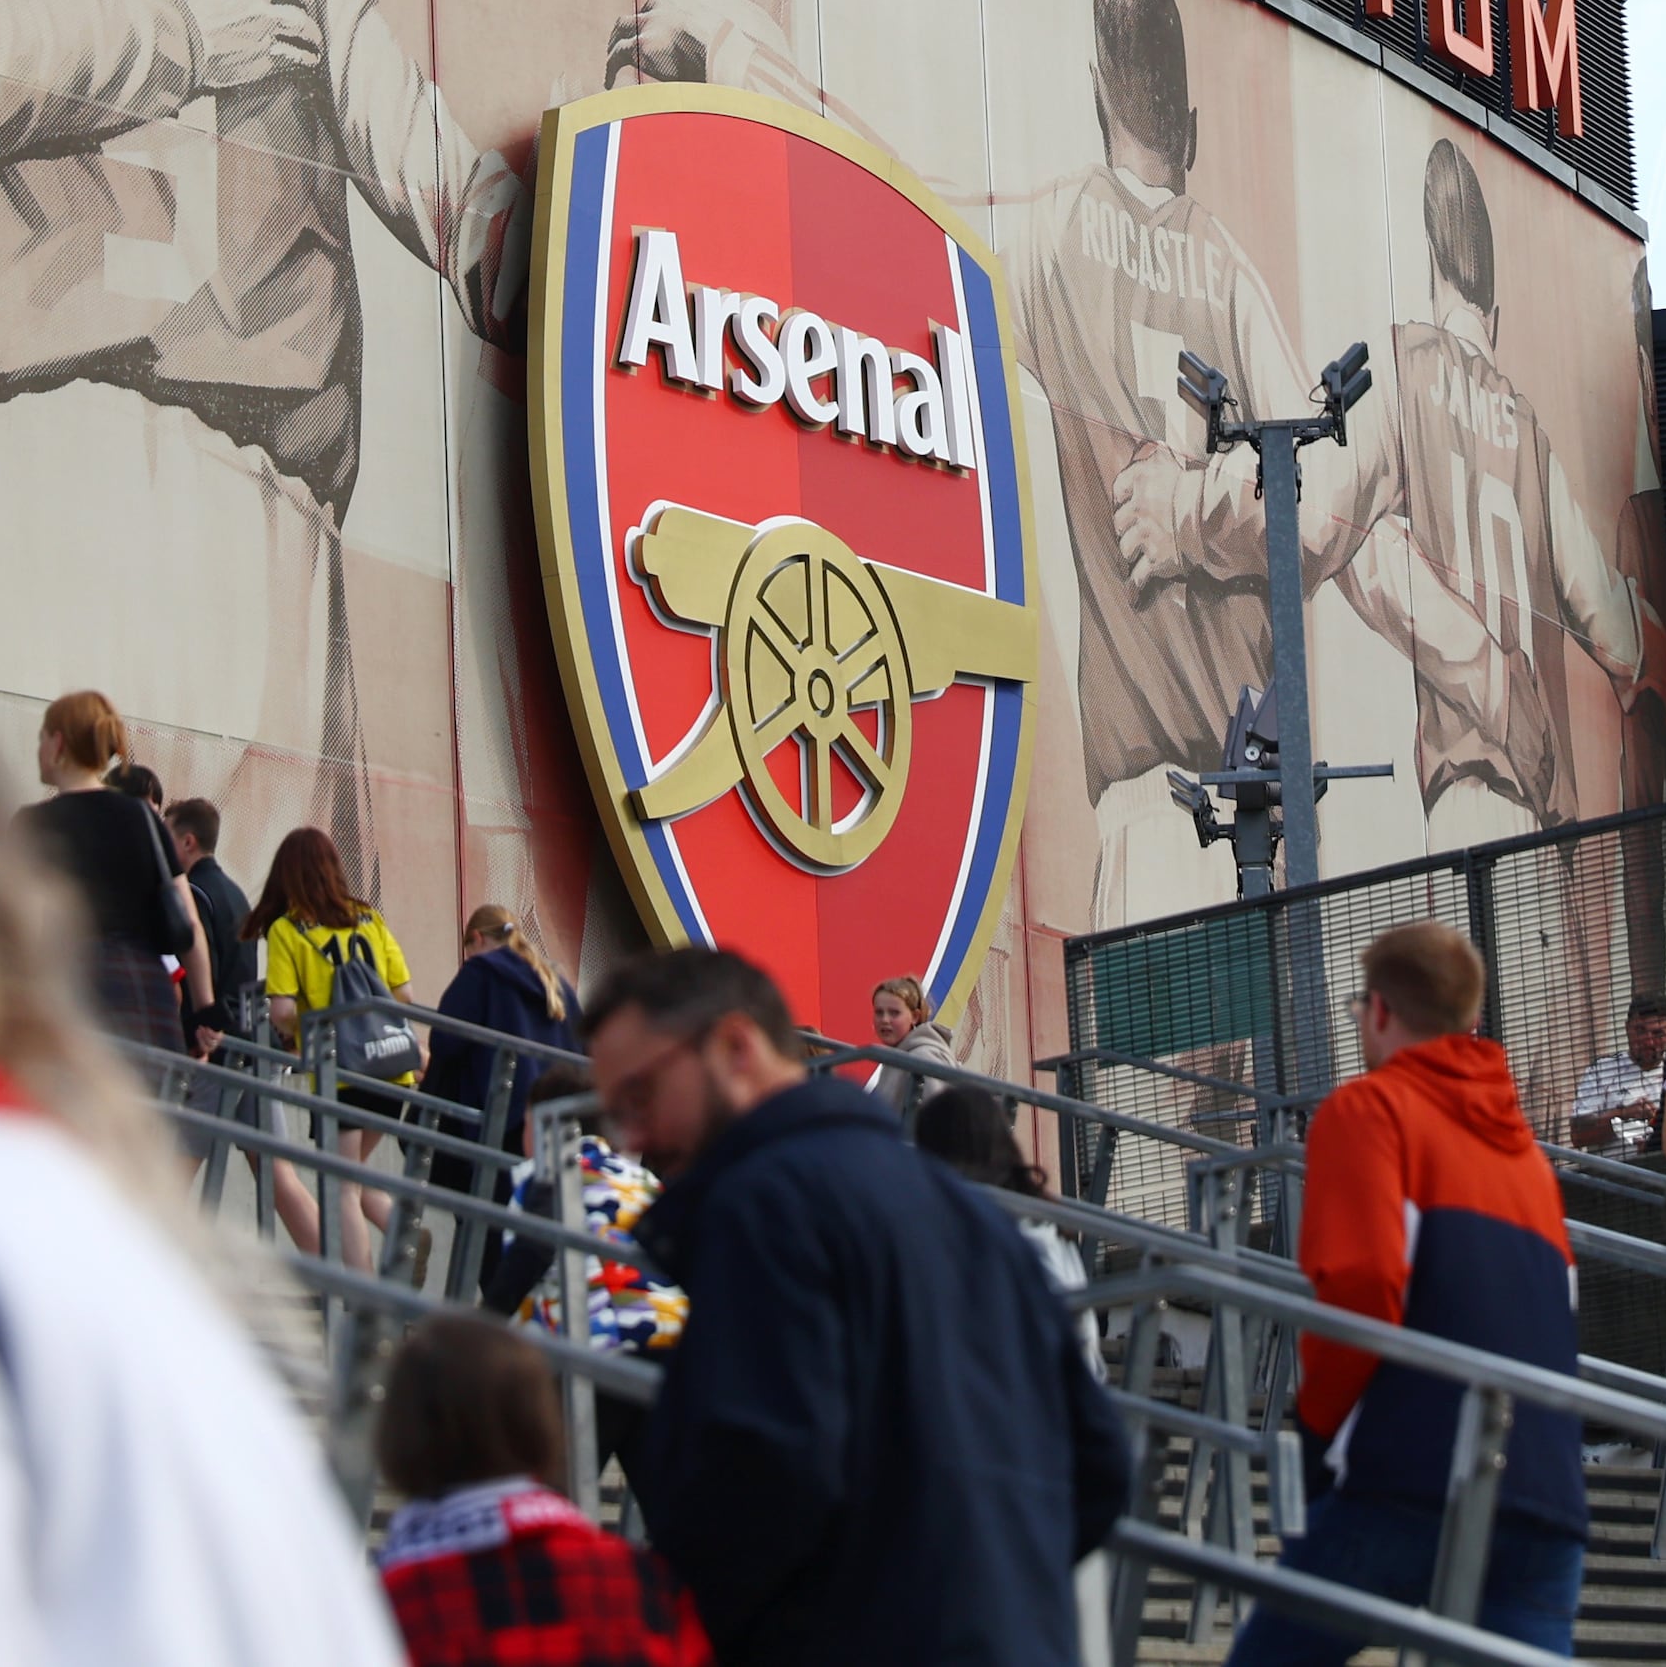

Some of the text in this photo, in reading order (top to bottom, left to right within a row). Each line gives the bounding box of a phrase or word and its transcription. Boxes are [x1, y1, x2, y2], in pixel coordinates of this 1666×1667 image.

[1080, 193, 1225, 312] ROCASTLE
[619, 231, 977, 470] Arsenal
[1429, 353, 1520, 450] JAMES
